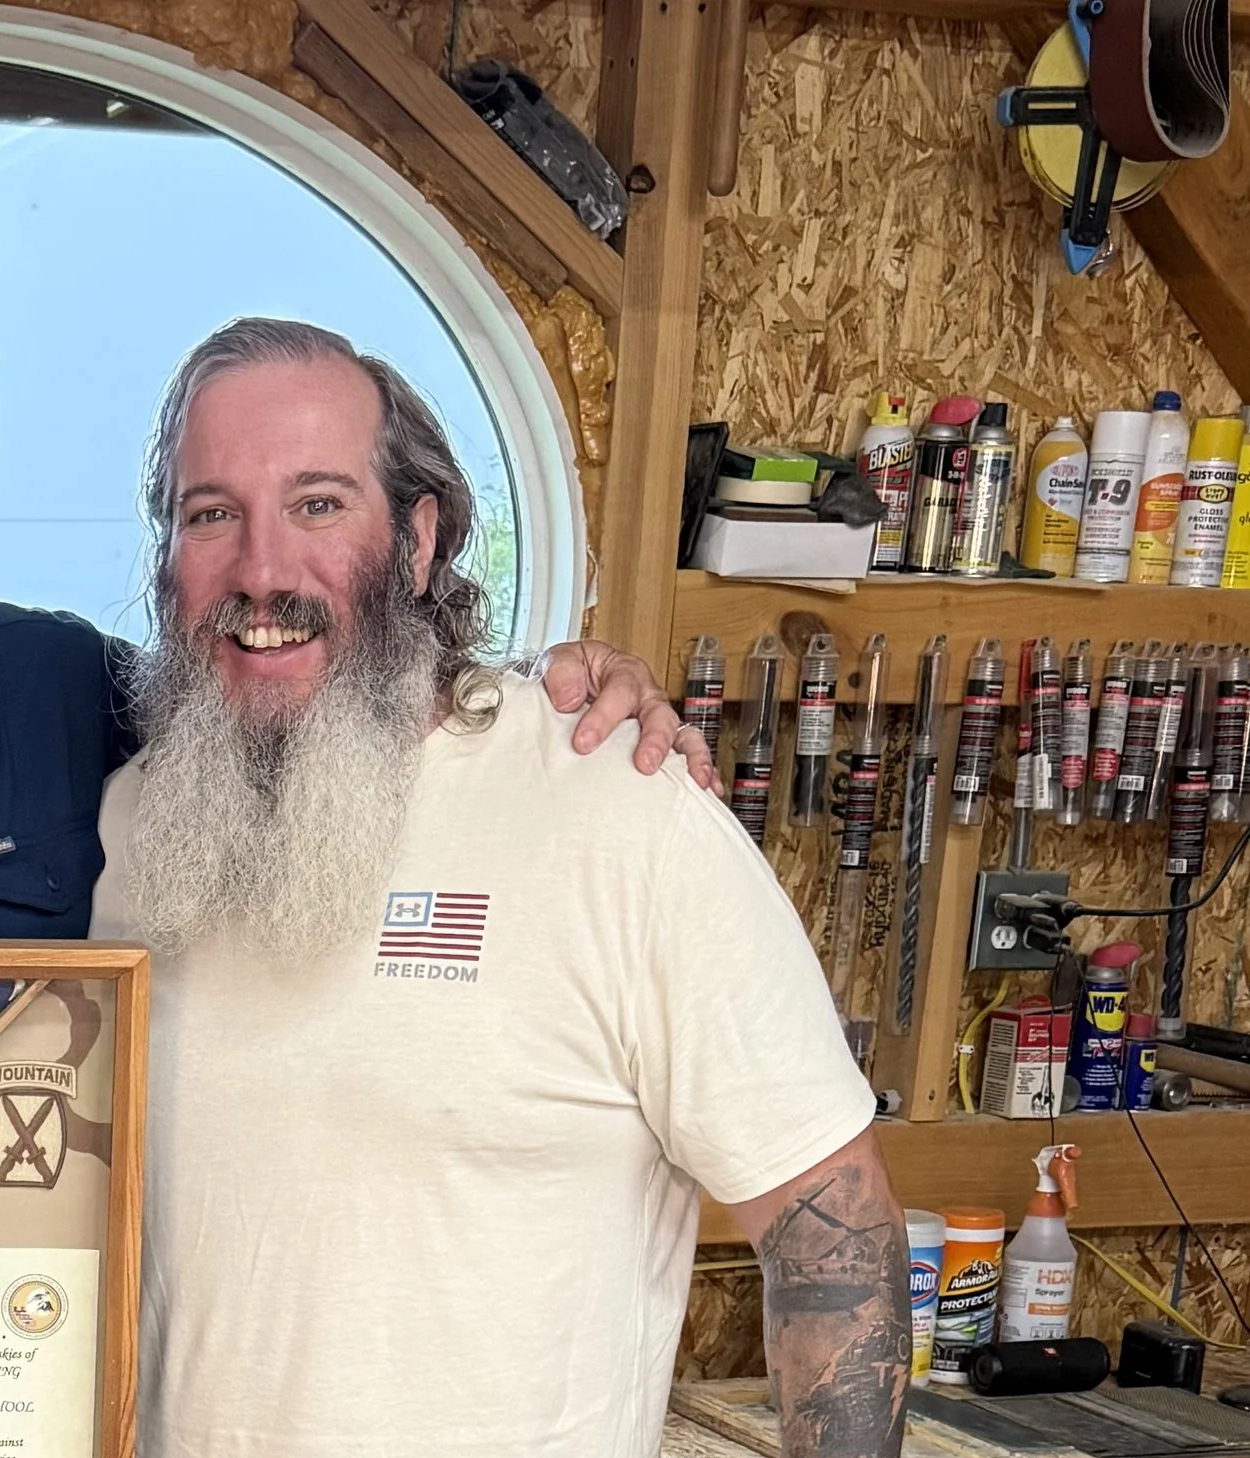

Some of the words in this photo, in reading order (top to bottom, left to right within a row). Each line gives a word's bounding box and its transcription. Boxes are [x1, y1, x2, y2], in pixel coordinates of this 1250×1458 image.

[1199, 508, 1224, 516] GLOSS
[373, 961, 479, 983] FREEDOM
[1037, 1268, 1072, 1285] HDX
[24, 1347, 39, 1362] of
